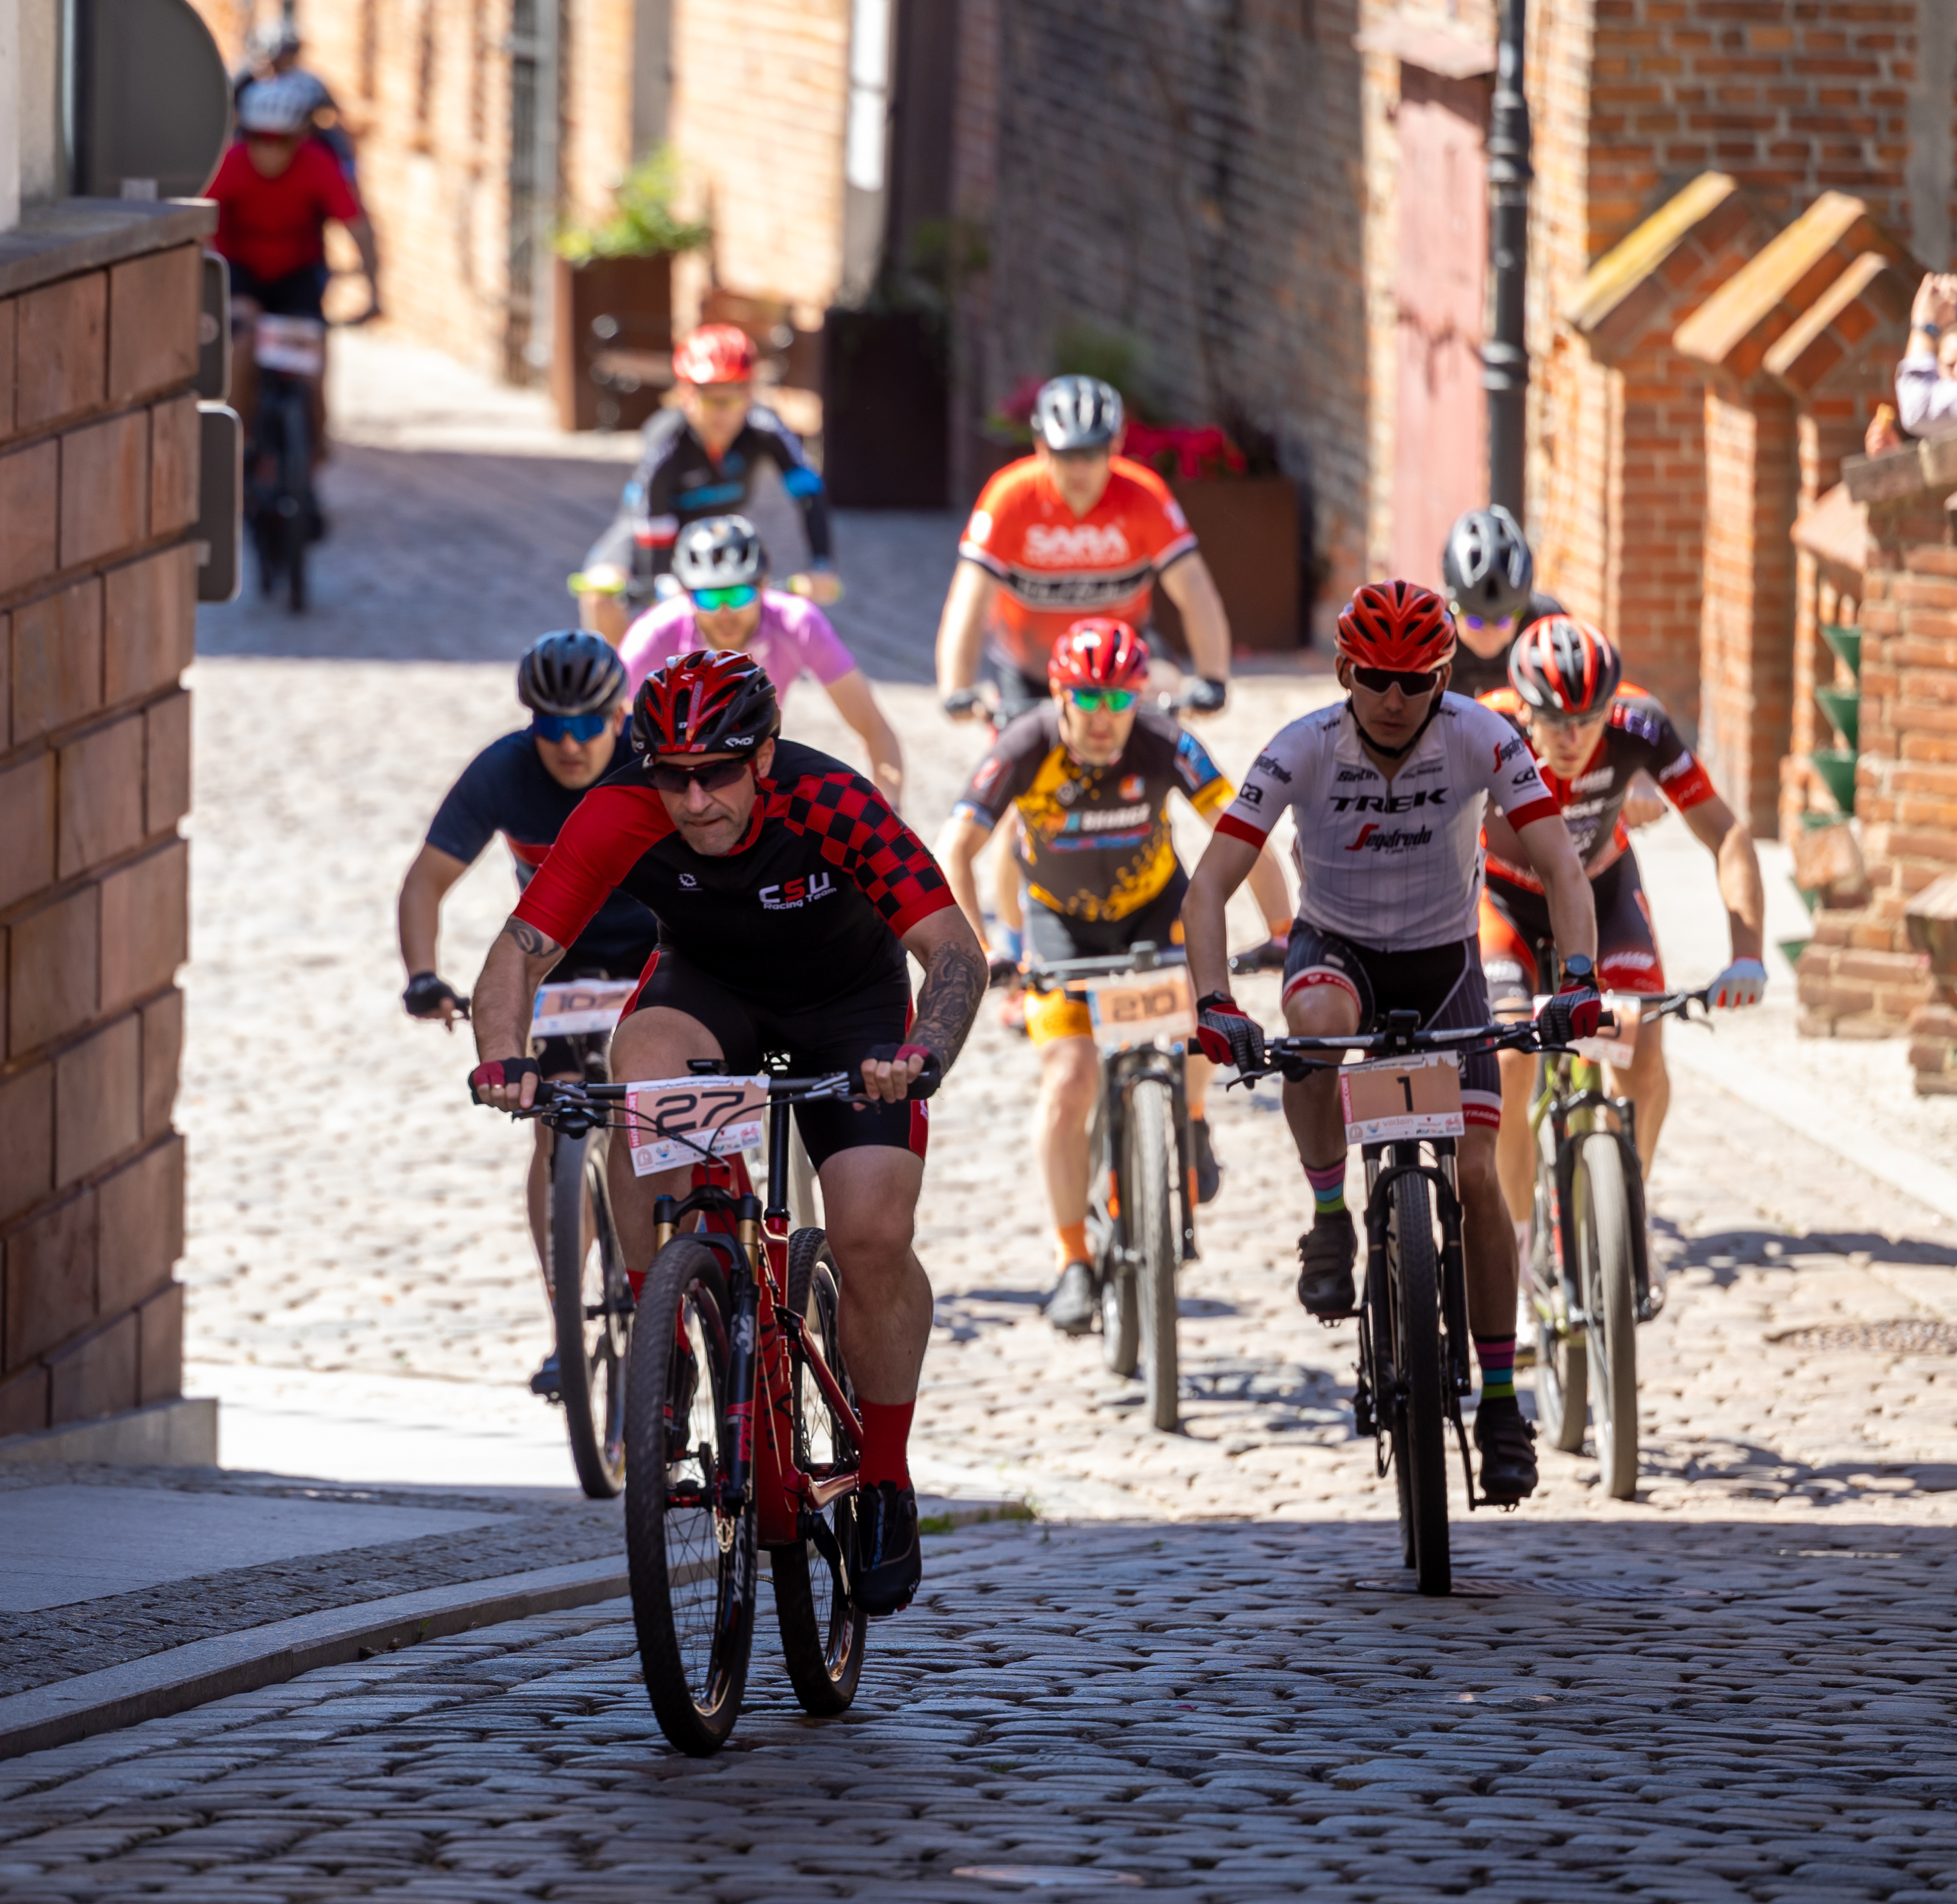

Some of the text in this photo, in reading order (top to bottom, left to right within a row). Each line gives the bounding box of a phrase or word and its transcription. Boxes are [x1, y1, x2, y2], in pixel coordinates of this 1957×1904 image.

[1330, 787, 1448, 814] TREK
[1345, 822, 1433, 853] Segafredo
[759, 871, 830, 903] CSU
[763, 887, 837, 909] Racing Team
[1396, 1075, 1413, 1112] 1
[655, 1091, 745, 1138] 27
